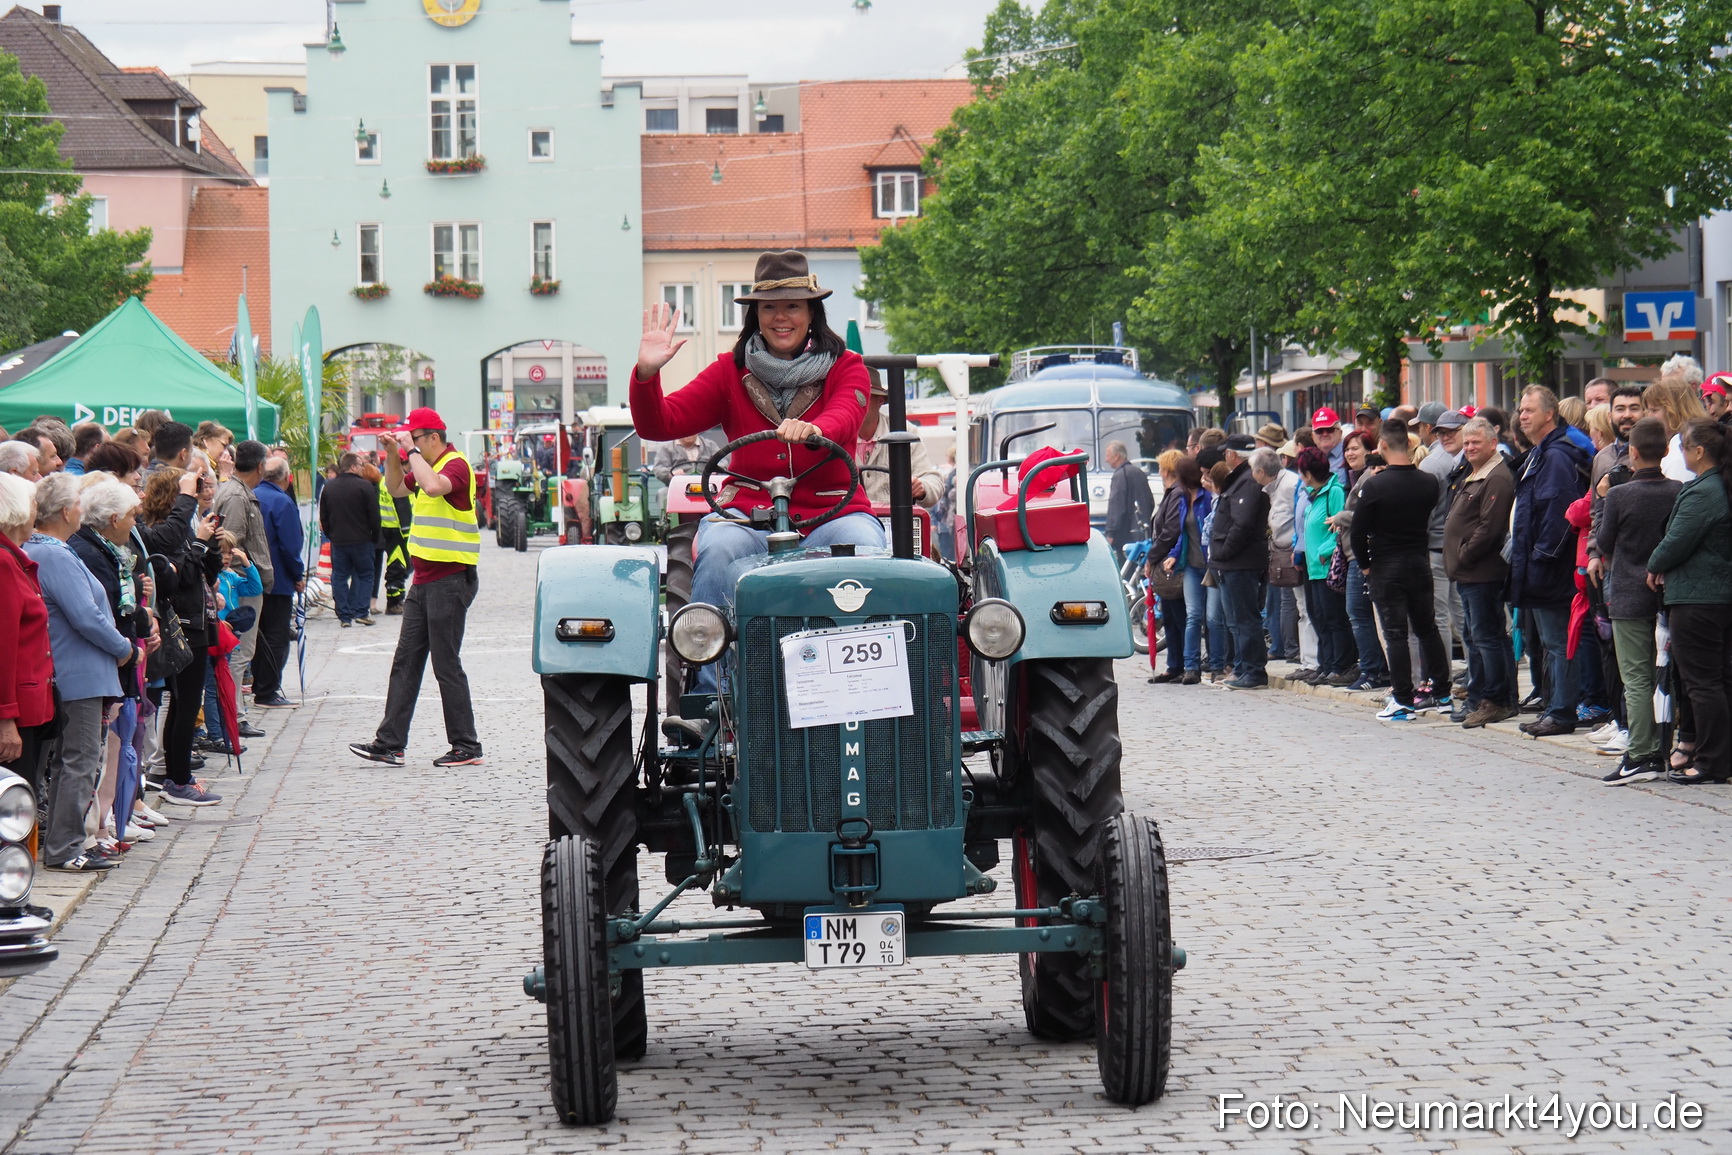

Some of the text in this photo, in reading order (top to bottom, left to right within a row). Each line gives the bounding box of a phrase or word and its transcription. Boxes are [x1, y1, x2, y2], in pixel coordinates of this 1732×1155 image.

[103, 406, 173, 426] DEKA
[841, 642, 882, 665] 259
[811, 918, 857, 940] D NM
[879, 940, 894, 950] 04
[880, 954, 894, 964] 10
